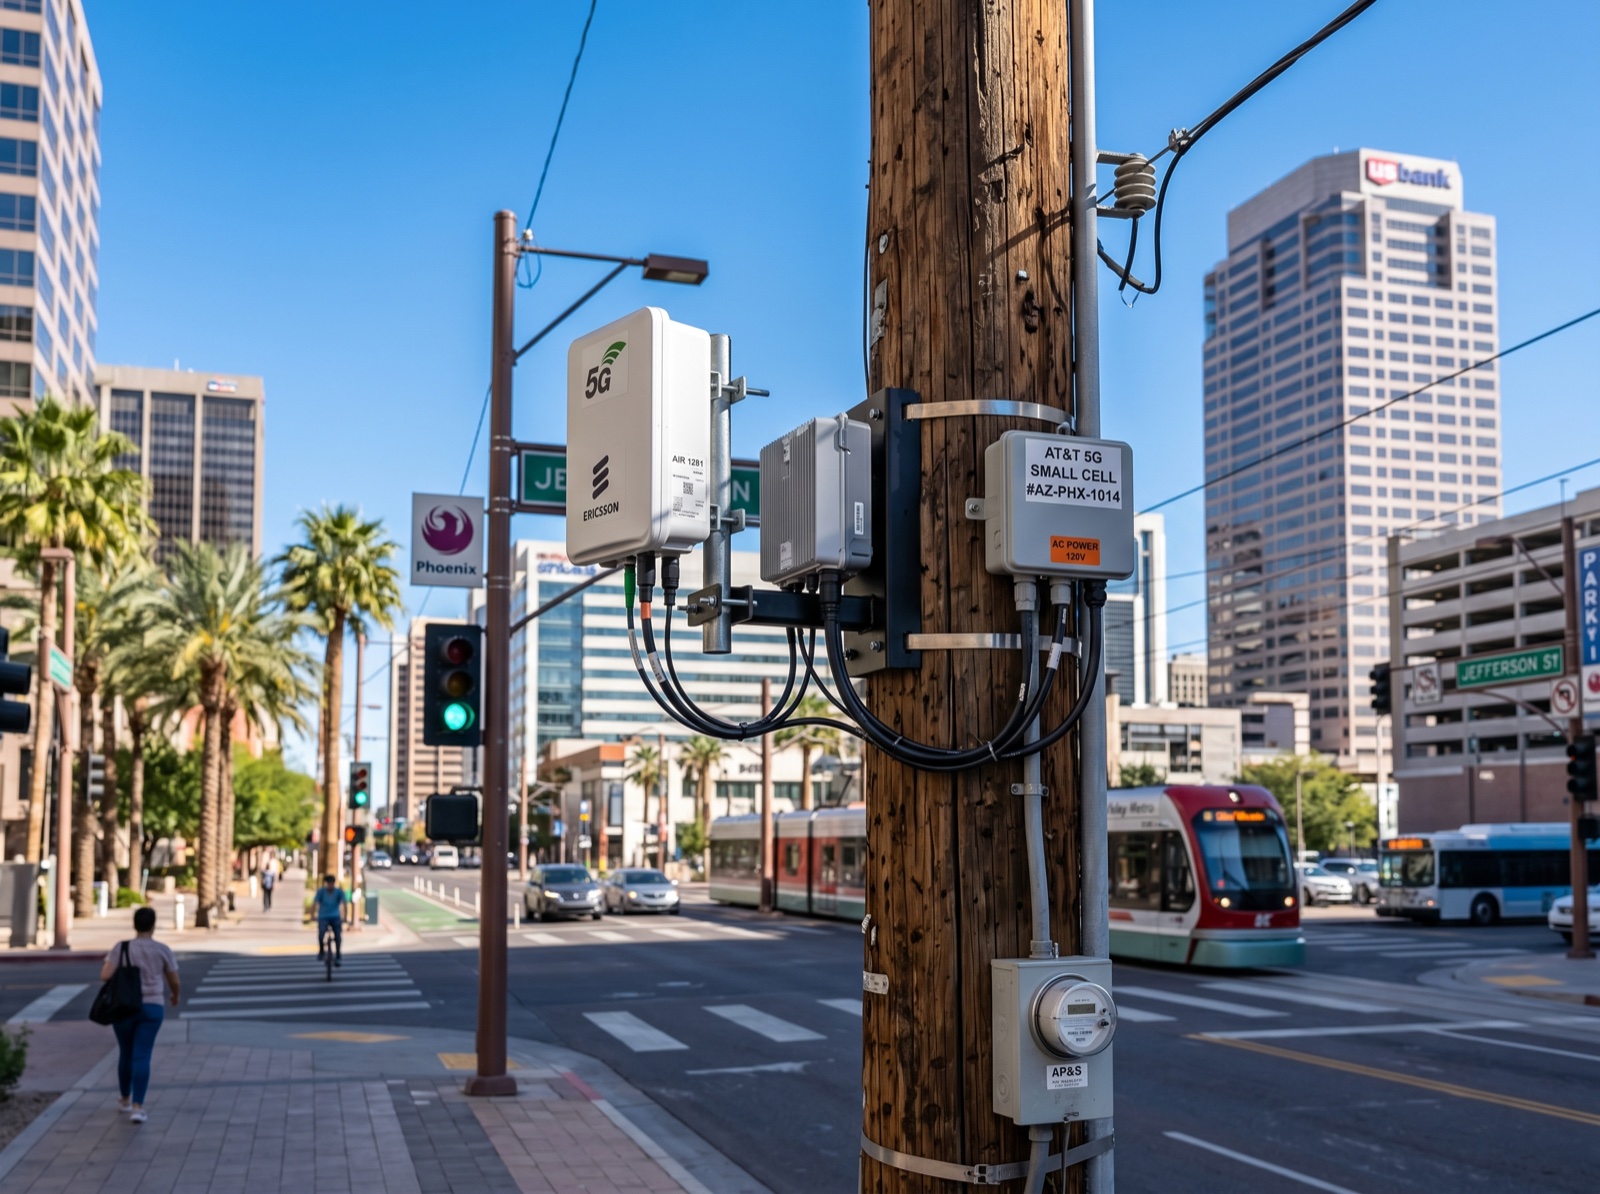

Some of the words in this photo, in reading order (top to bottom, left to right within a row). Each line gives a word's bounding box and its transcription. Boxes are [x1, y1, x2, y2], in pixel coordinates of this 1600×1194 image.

[585, 365, 612, 399] 5G
[672, 455, 686, 464] AIR
[688, 458, 703, 467] 1281
[1045, 446, 1080, 461] AT&T
[1084, 450, 1103, 464] 5G
[1030, 464, 1078, 480] SMALL
[1081, 468, 1117, 484] CELL
[1026, 483, 1120, 503] #AZ-PHX-1014
[583, 501, 619, 522] ERICSSON
[1052, 540, 1064, 549] AC
[1067, 541, 1098, 551] POWER
[1066, 552, 1086, 561] 120V
[416, 560, 477, 576] Phoenix
[1461, 656, 1538, 682] JEFFERSON
[1543, 653, 1560, 670] ST
[1052, 1065, 1082, 1078] AP&S
